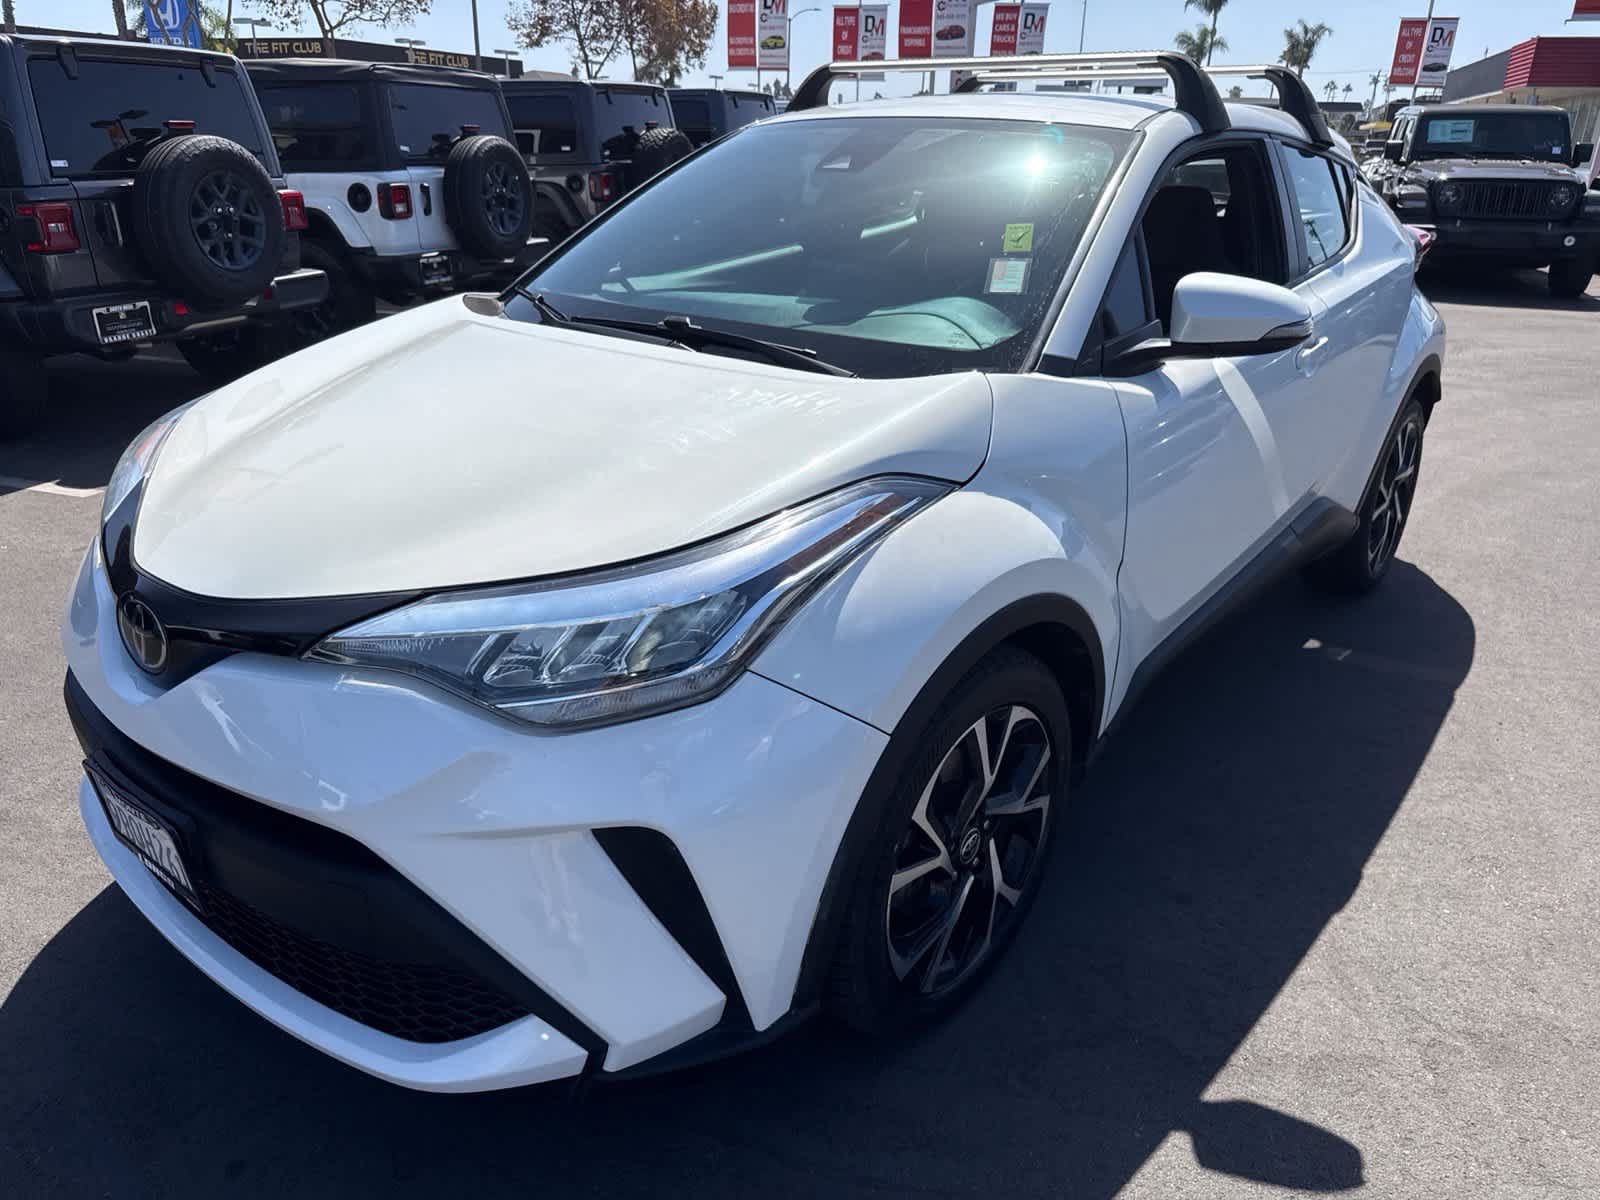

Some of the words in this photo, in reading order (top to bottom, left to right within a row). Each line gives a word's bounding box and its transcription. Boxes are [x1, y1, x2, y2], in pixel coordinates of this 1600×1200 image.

[244, 42, 269, 54] THE
[271, 42, 290, 54] FIT
[292, 42, 322, 54] CLUB
[429, 52, 445, 66] FIT
[447, 55, 470, 69] CLUB
